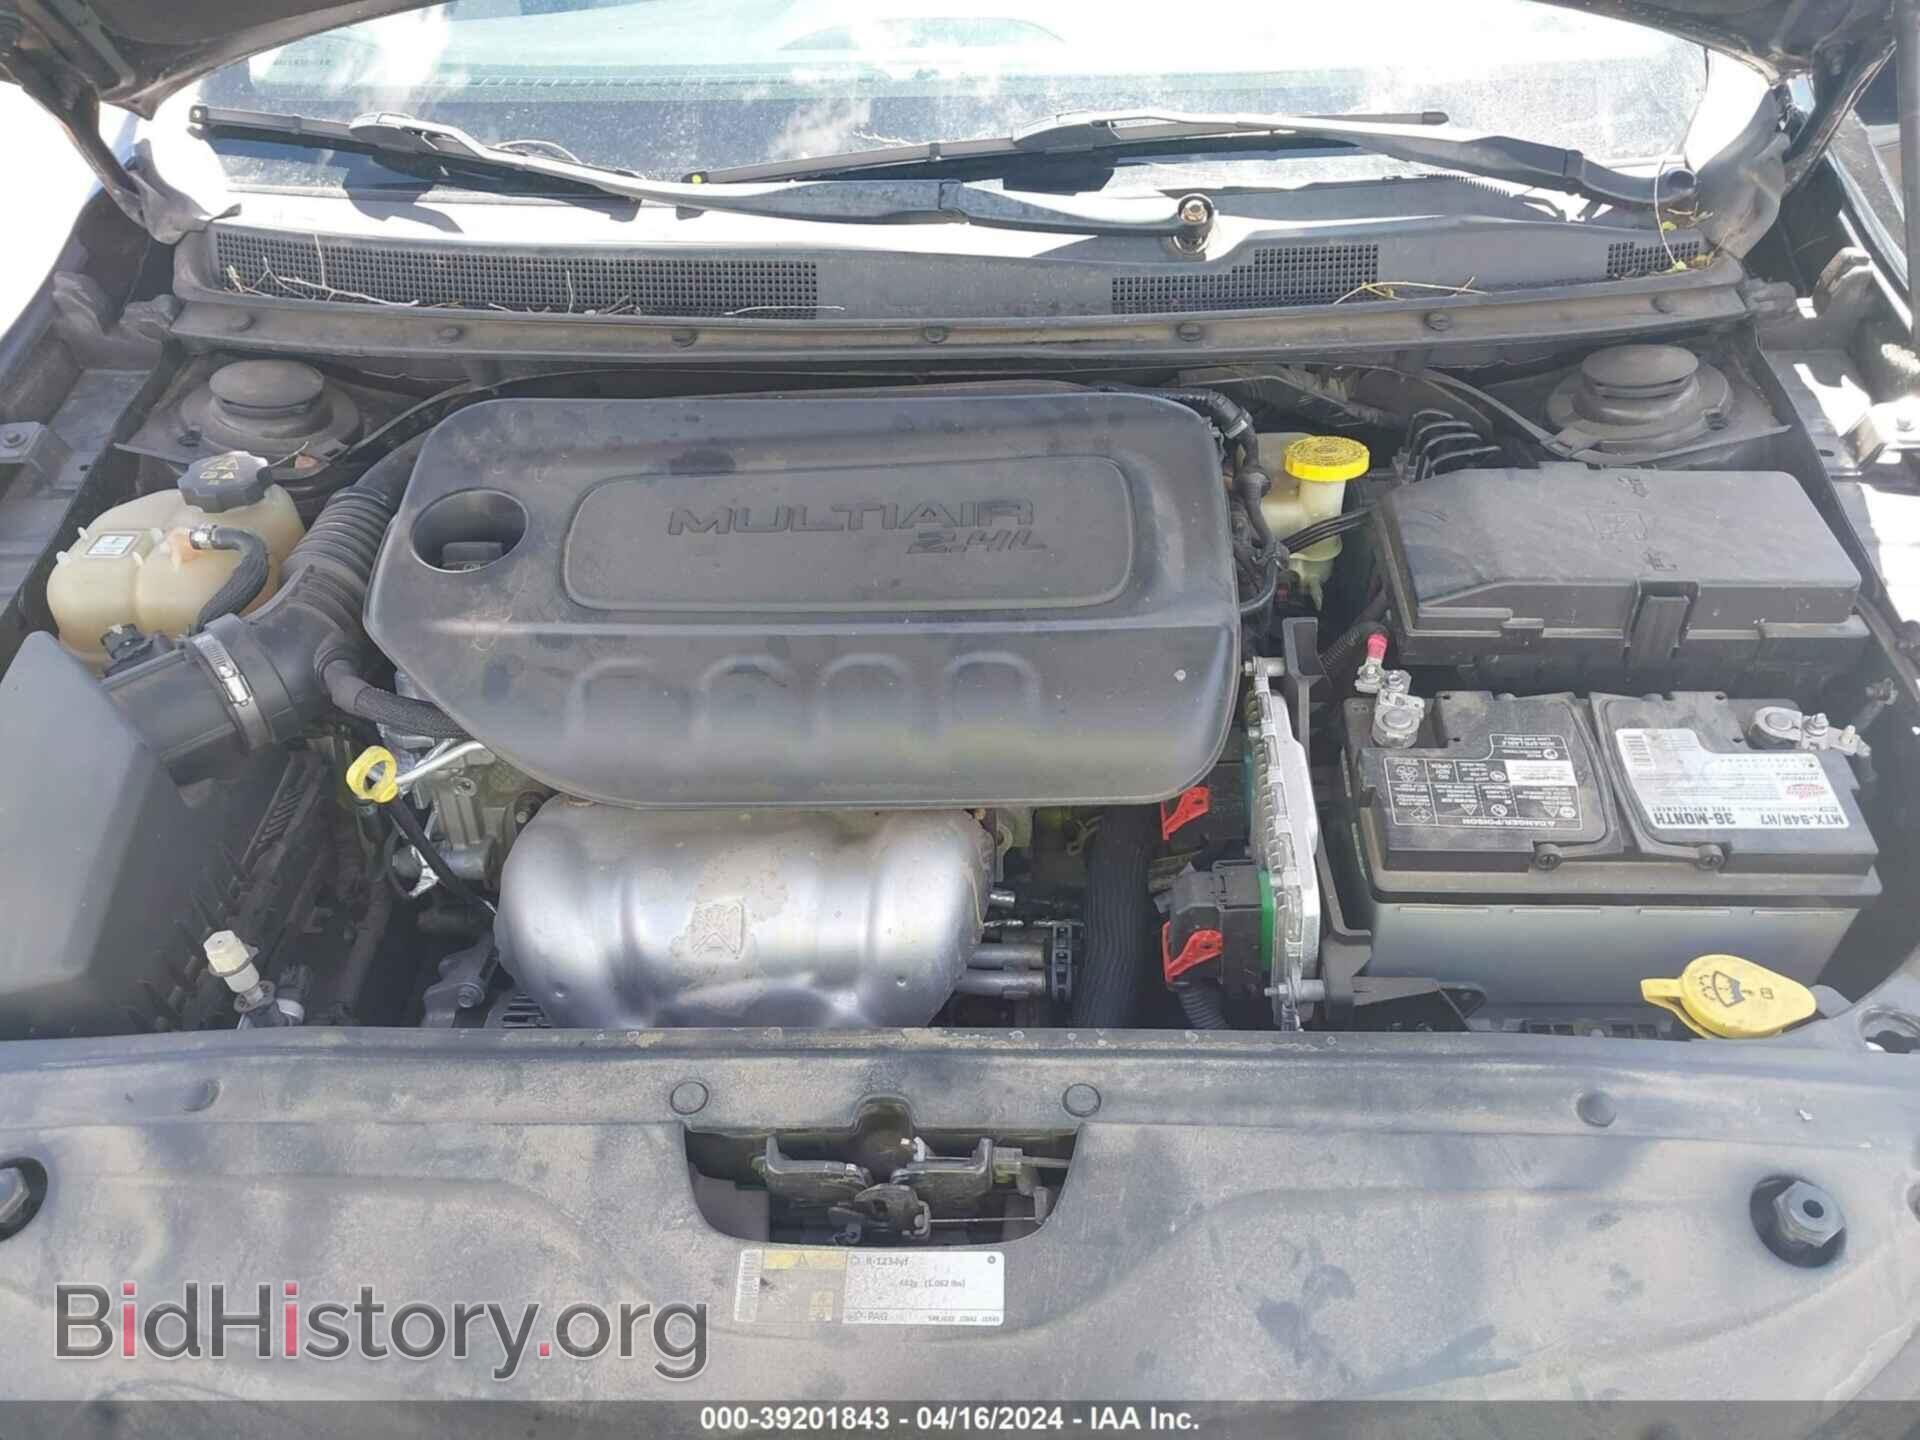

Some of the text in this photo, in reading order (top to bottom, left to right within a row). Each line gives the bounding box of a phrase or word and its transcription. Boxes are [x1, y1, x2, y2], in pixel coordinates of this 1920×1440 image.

[668, 501, 1034, 536] MULTIAIR
[1652, 811, 1845, 826] 36-MONTH MTX-94R/H7
